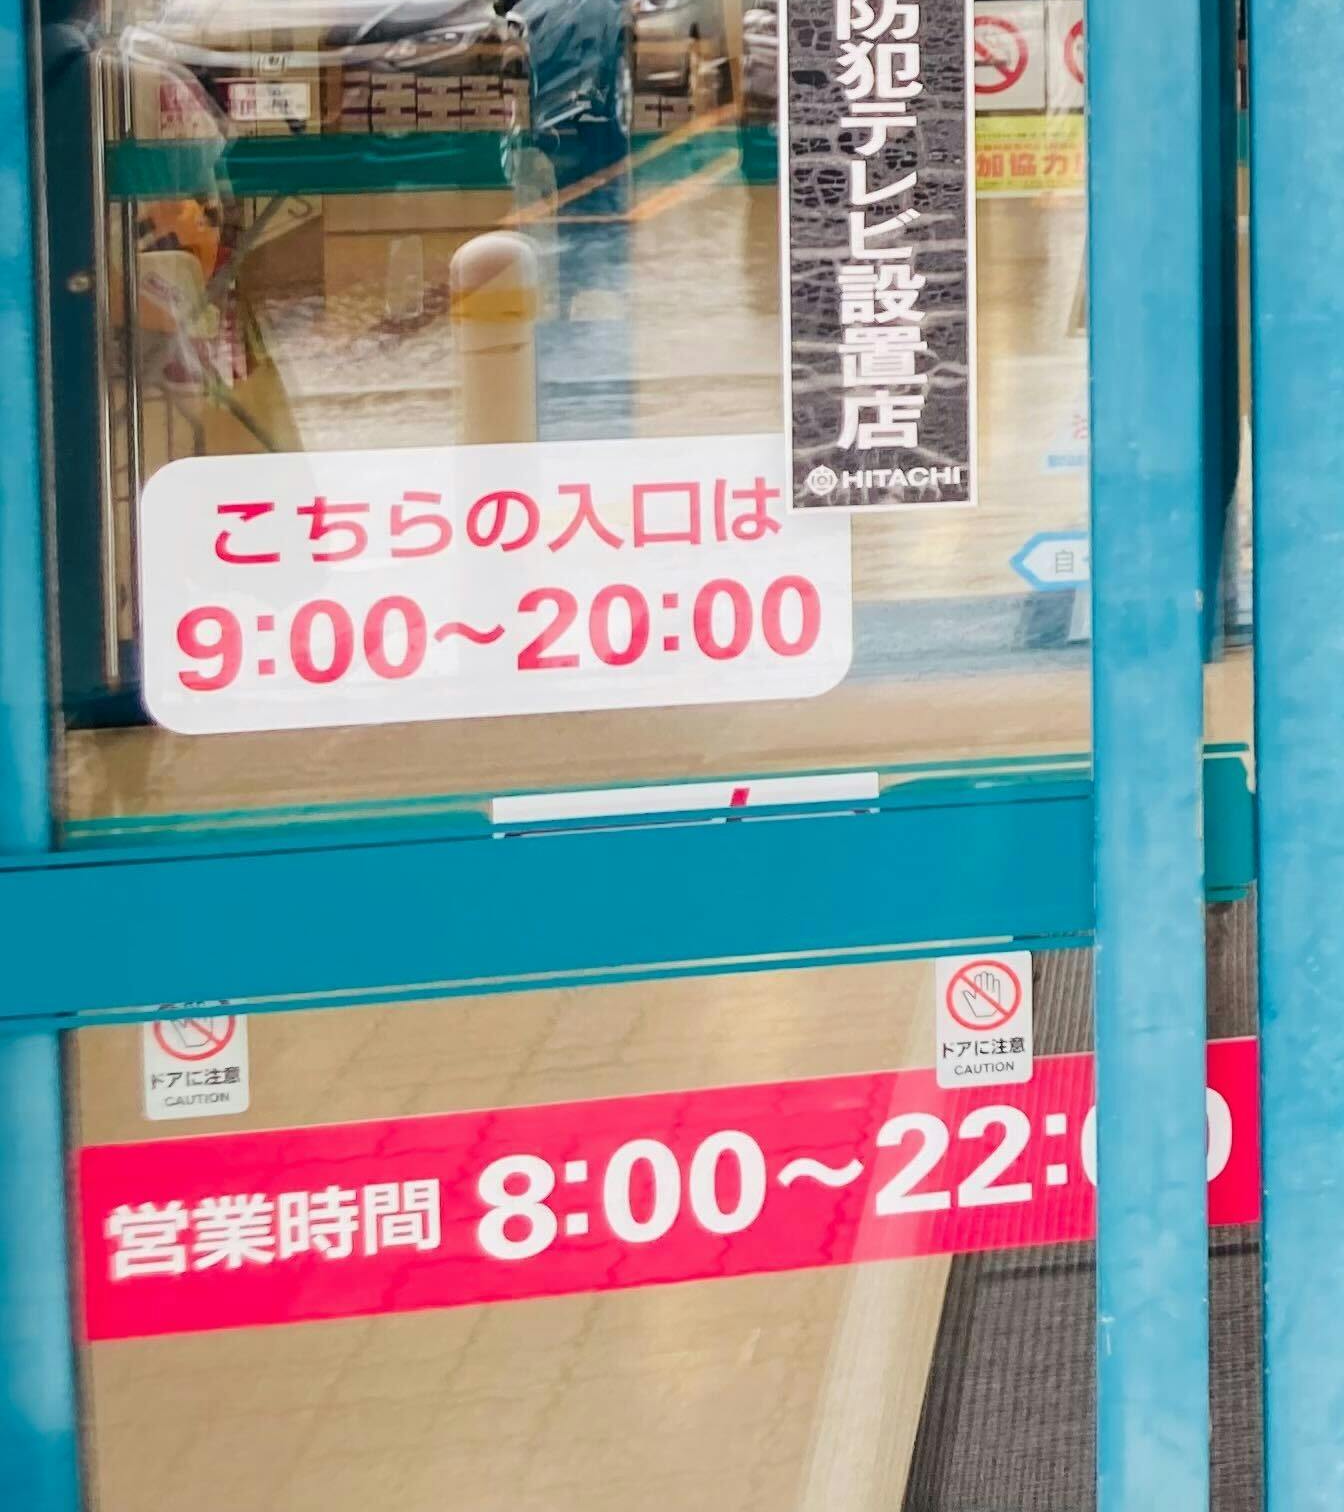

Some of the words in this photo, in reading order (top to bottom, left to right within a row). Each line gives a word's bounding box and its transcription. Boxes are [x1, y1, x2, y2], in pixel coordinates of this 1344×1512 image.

[841, 464, 963, 488] HITACHI
[213, 475, 783, 566] こちらの入口は
[942, 1036, 1025, 1059] ドアに注意
[151, 1066, 240, 1090] ドアに注意
[953, 1061, 1015, 1076] CAUTION
[164, 1092, 230, 1107] CAUTION
[106, 1178, 441, 1283] 営業時間
